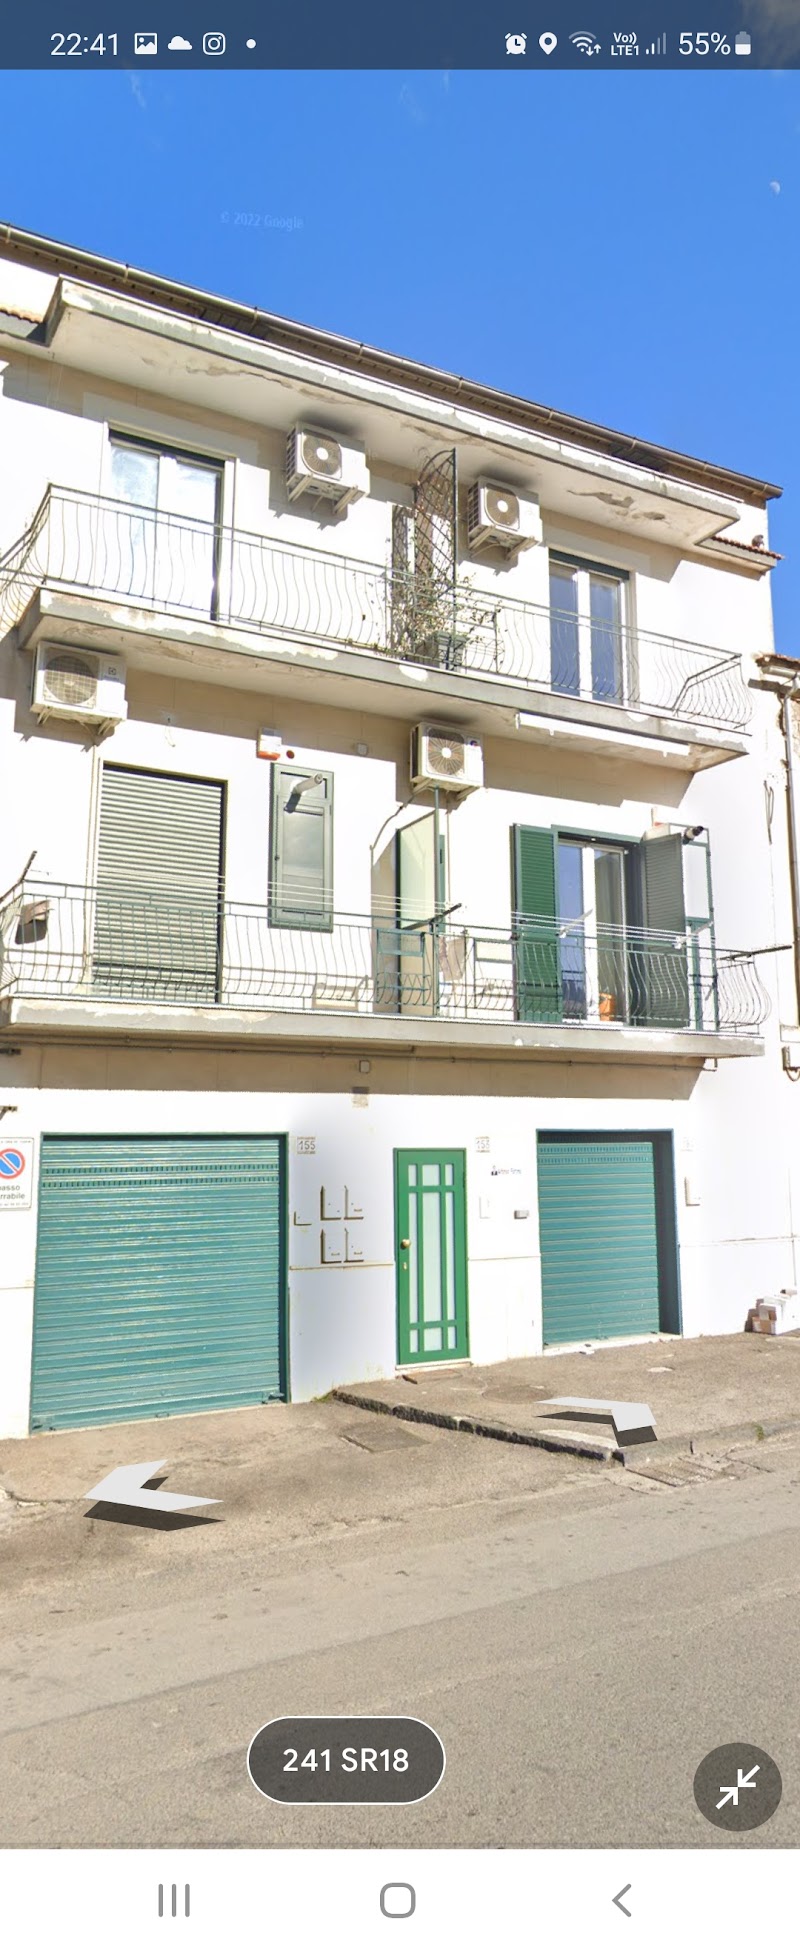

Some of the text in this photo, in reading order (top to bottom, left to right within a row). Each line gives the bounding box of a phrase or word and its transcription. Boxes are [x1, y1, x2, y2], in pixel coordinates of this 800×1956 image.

[298, 1140, 316, 1150] 155
[0, 1184, 21, 1192] asso
[0, 1192, 26, 1200] rrabile
